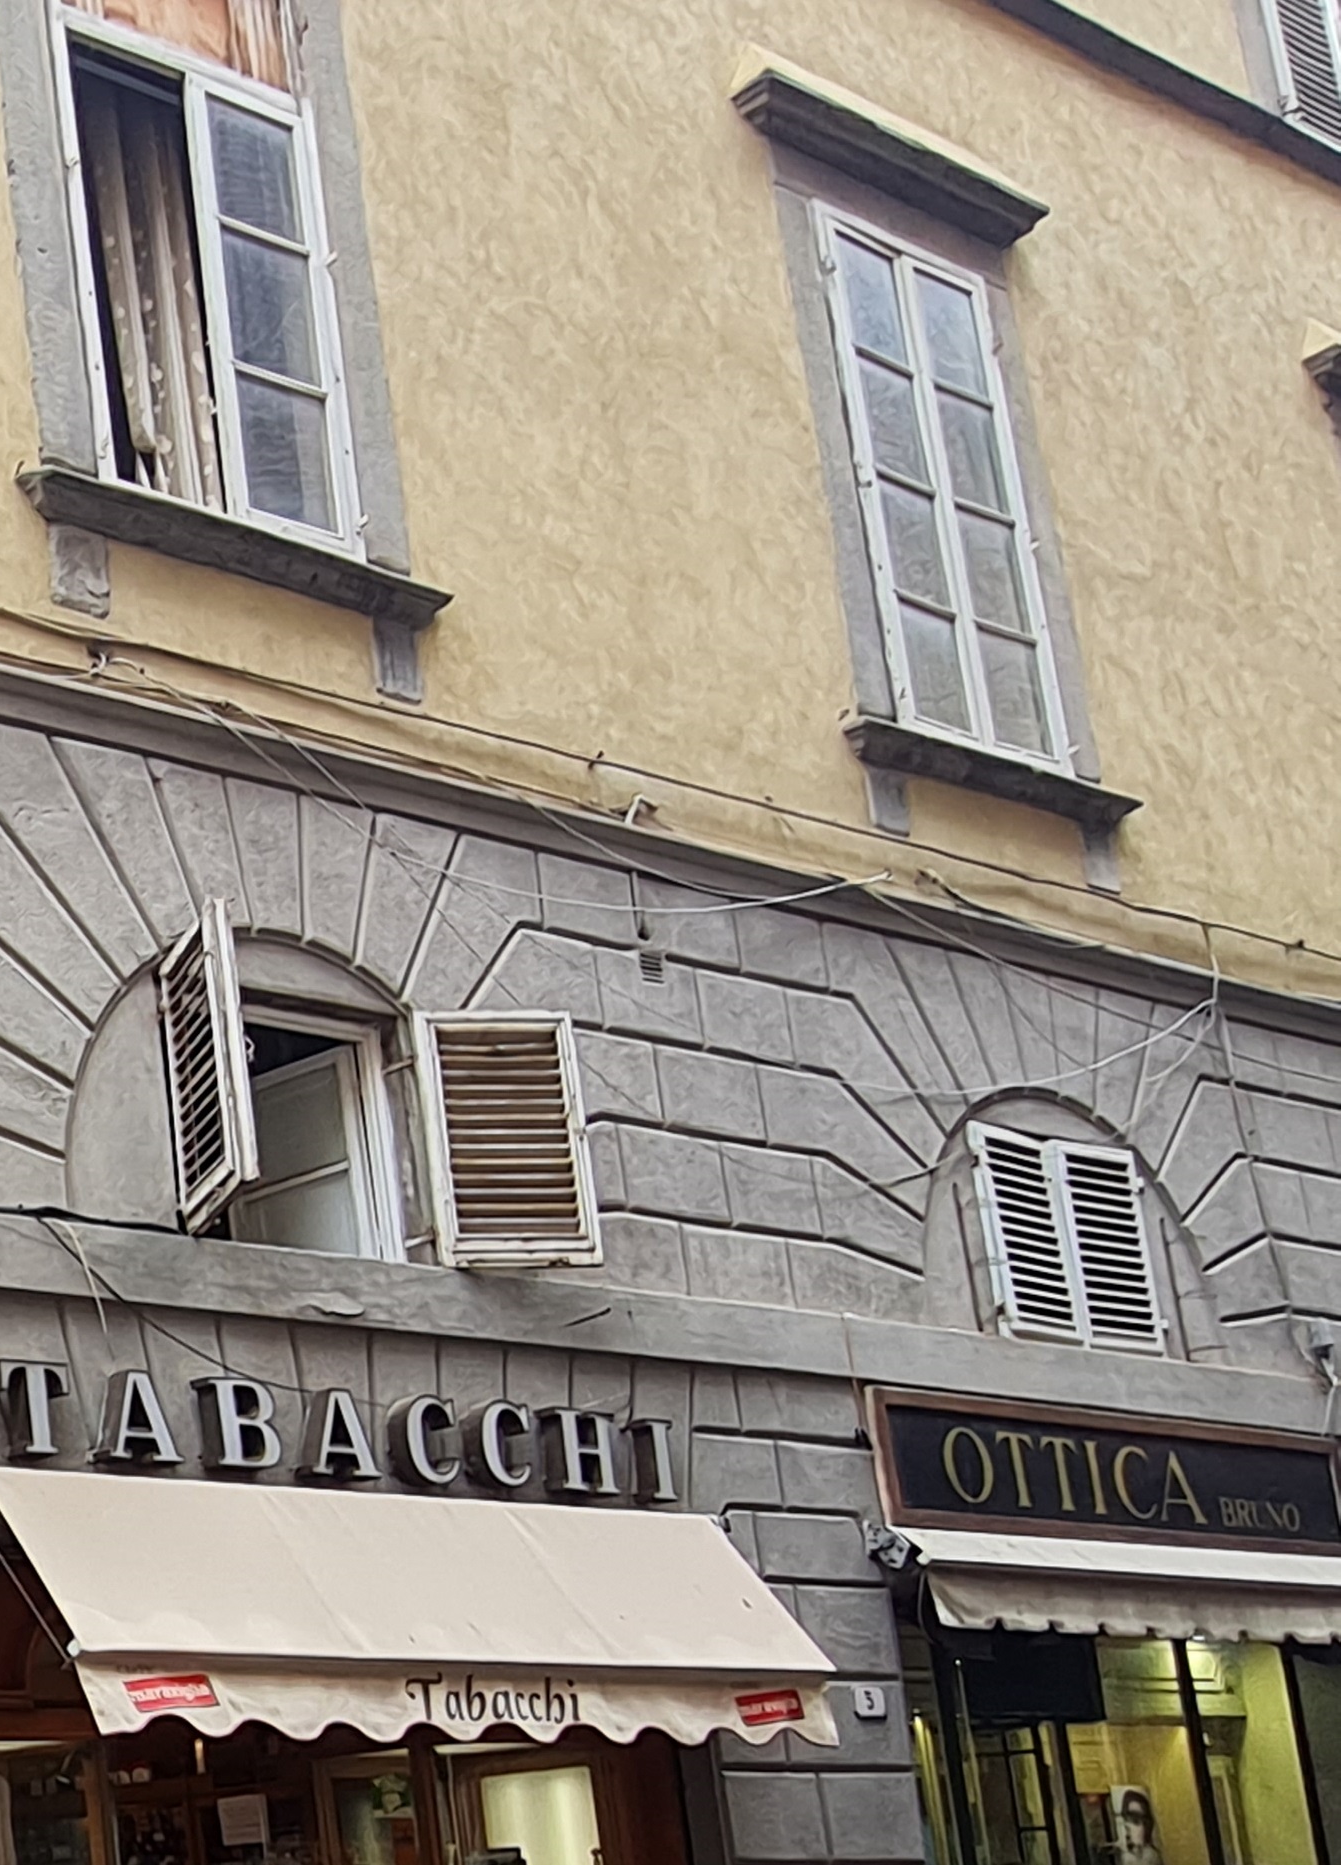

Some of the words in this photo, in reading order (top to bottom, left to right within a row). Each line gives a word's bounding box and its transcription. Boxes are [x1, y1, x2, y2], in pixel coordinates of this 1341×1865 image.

[942, 1426, 1208, 1526] OTTICA
[405, 1671, 581, 1724] Tabacchi
[863, 1689, 875, 1711] 5
